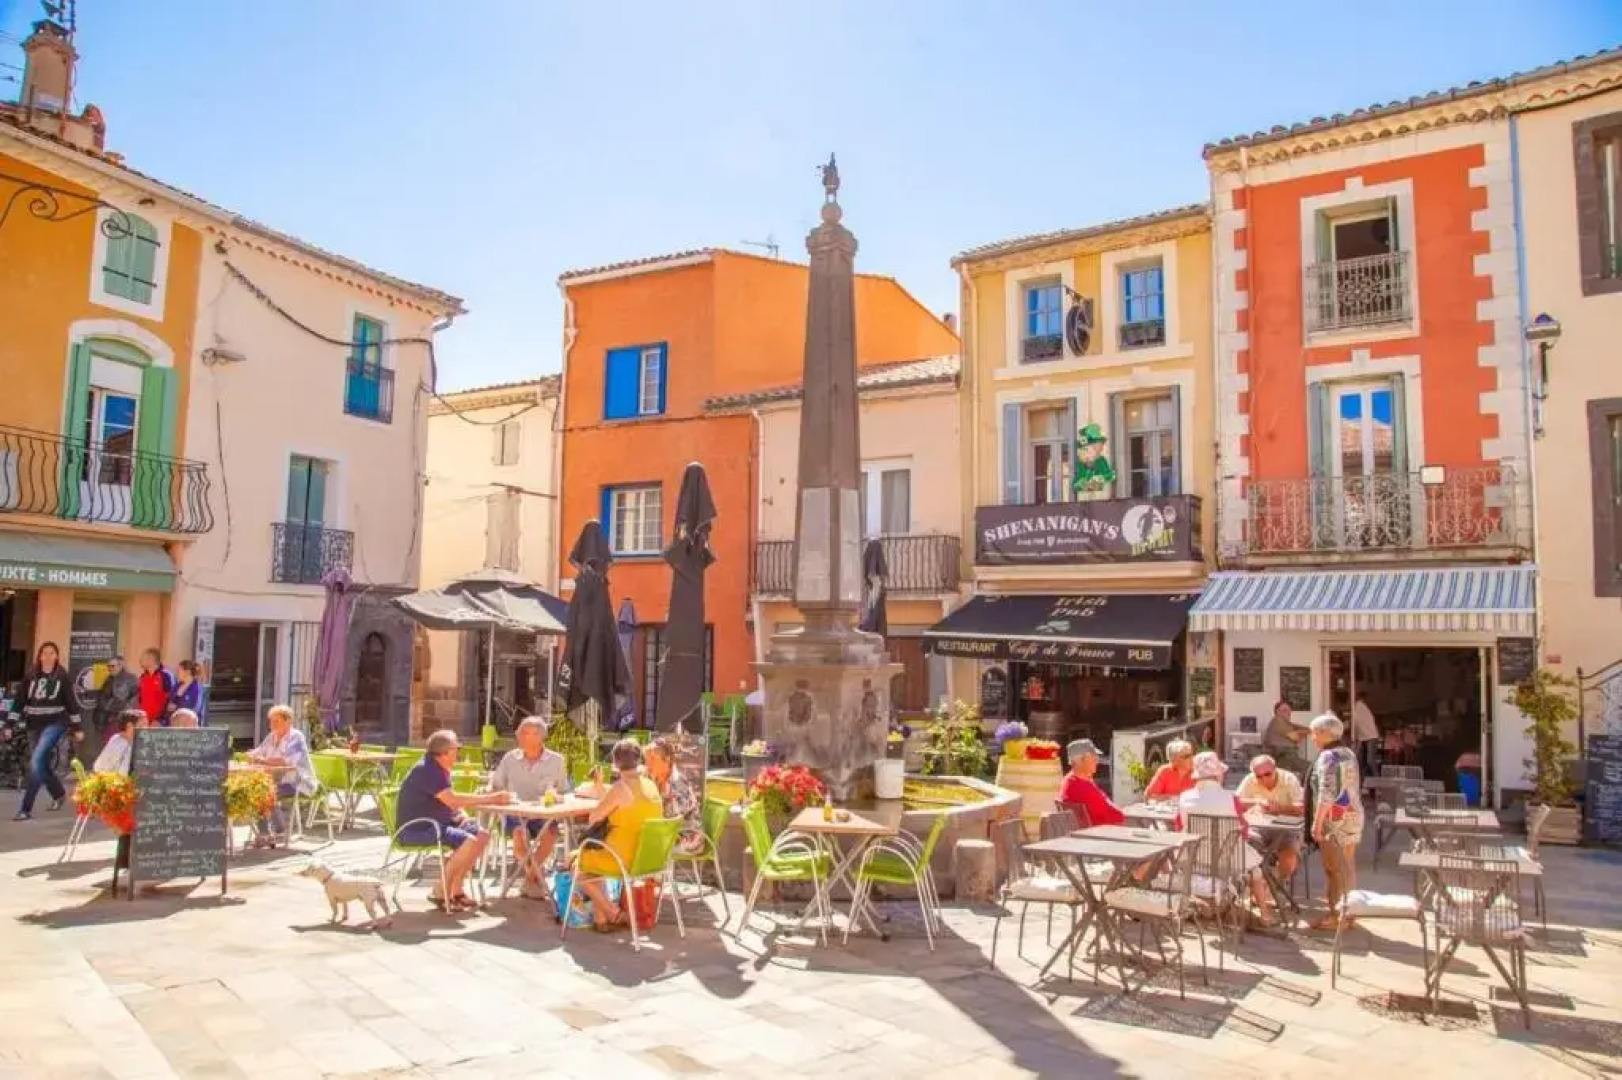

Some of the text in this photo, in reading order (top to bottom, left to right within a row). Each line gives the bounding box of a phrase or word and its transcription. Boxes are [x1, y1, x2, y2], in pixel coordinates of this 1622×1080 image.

[984, 515, 1119, 543] SHENANIGAN'S
[0, 566, 37, 581] IXTE
[48, 569, 107, 585] HOMMES
[937, 640, 997, 653] RESTAURANT
[1128, 649, 1154, 661] PUB
